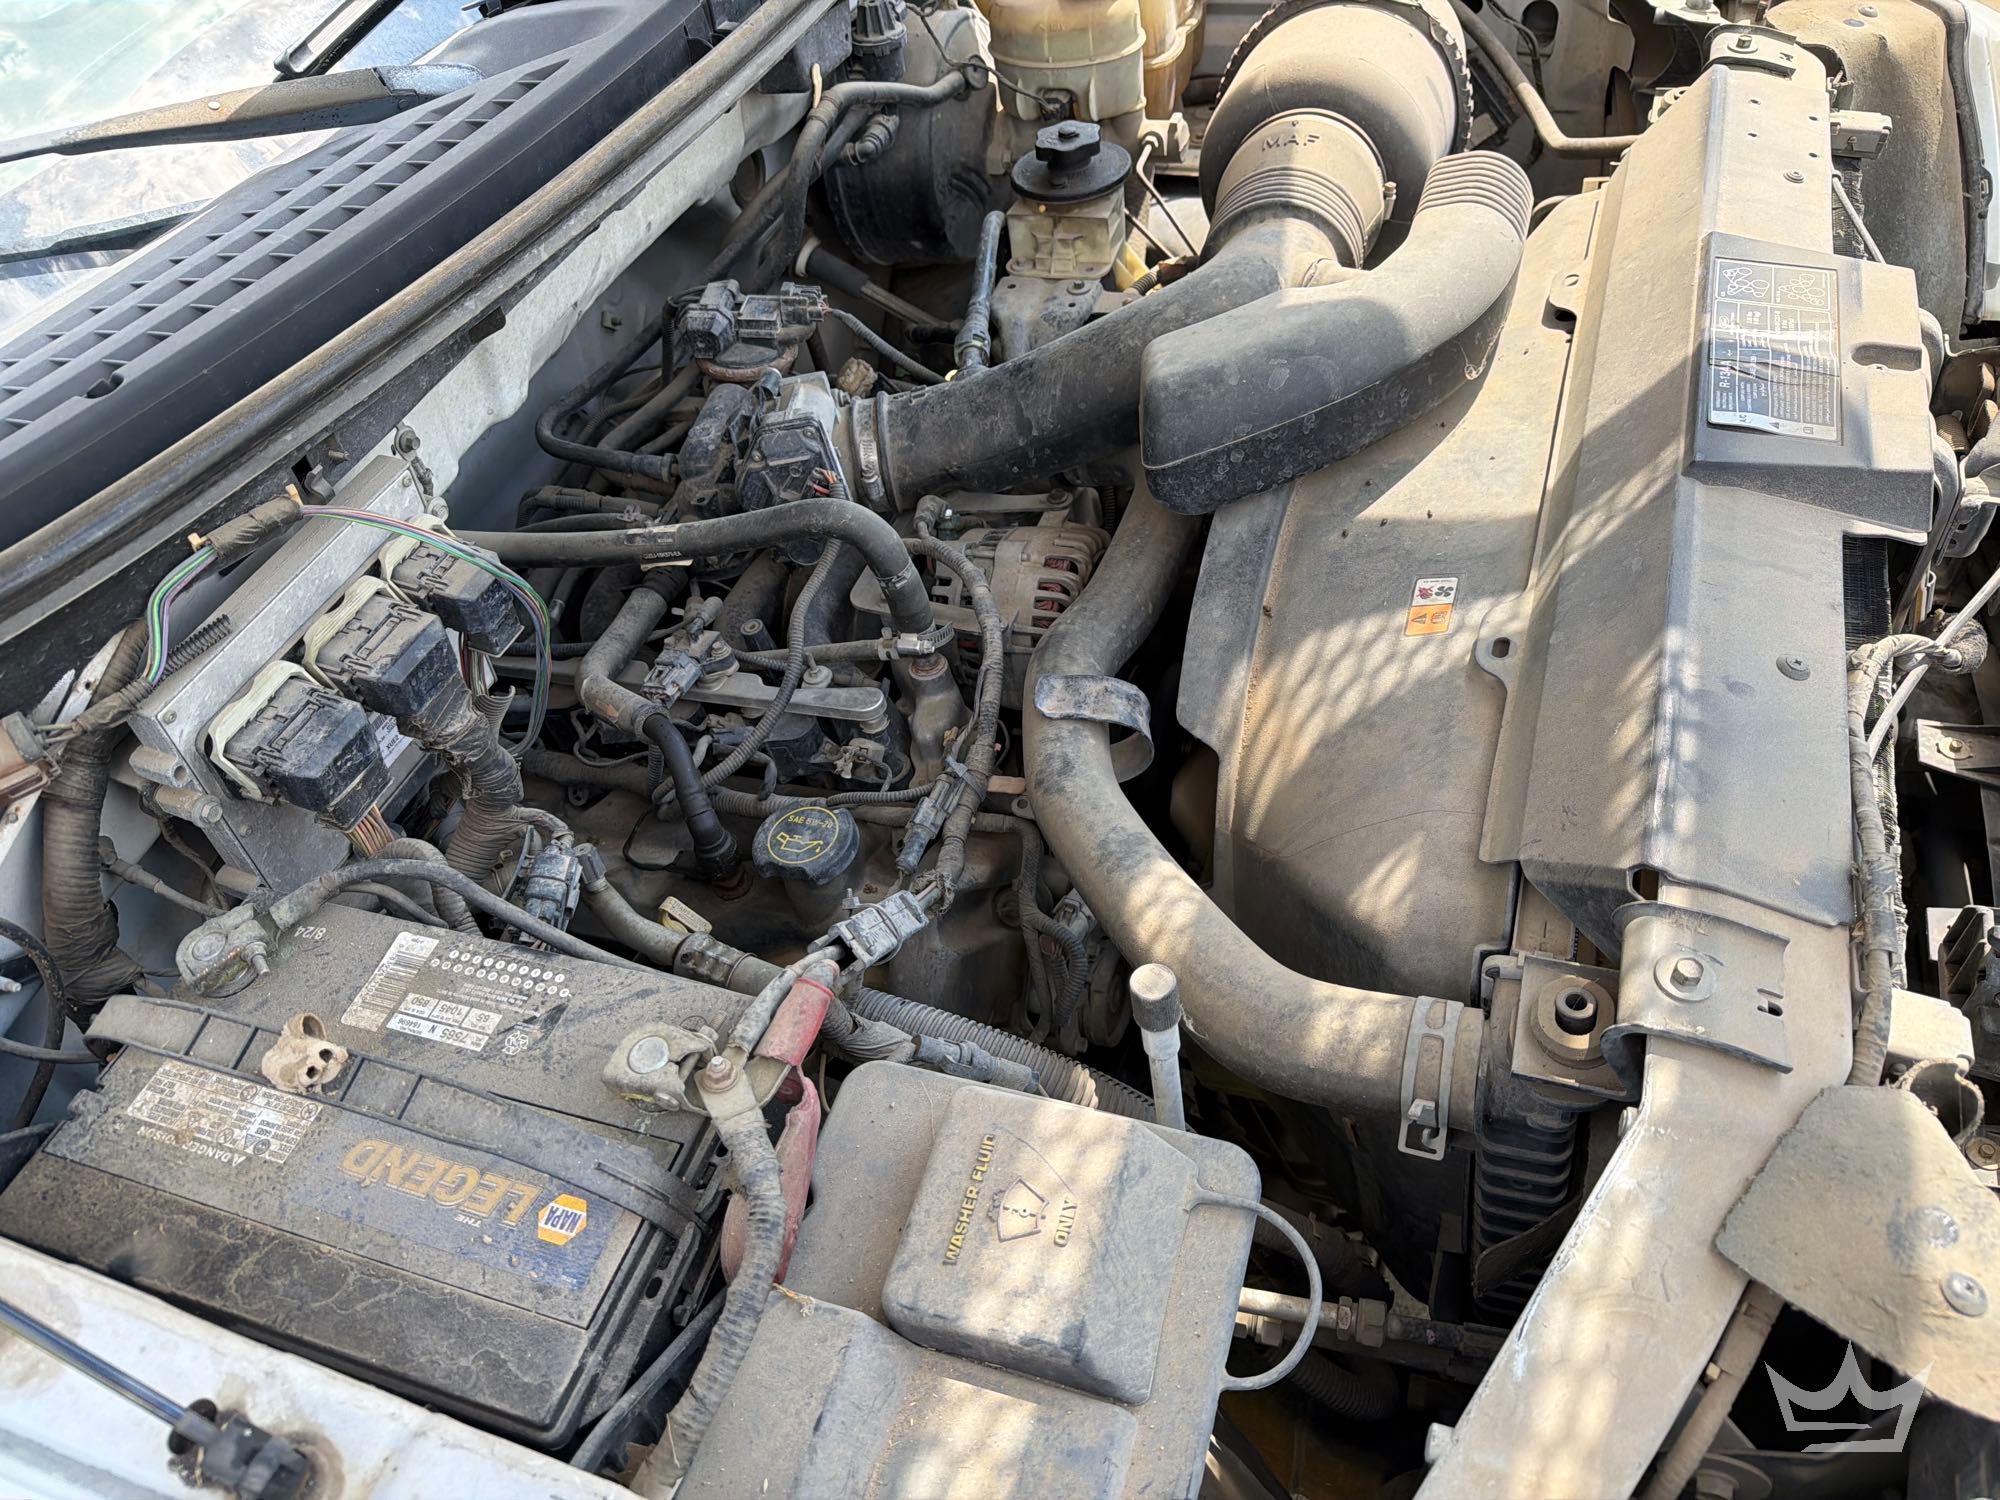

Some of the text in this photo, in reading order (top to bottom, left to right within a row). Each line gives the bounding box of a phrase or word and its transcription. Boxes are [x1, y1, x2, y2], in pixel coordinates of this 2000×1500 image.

[1259, 130, 1321, 152] MAF
[384, 733, 400, 750] XUE2
[787, 814, 806, 824] SAE
[293, 924, 327, 940] 8/24
[409, 995, 431, 1008] 850
[437, 1002, 465, 1019] 1045
[474, 1011, 492, 1024] 65
[427, 1022, 438, 1035] N
[438, 1026, 470, 1043] 7565
[181, 1138, 233, 1163] DANGER
[337, 1137, 544, 1229] LEGEND
[941, 1133, 996, 1267] WASHER FLUID
[453, 1213, 482, 1227] THE
[545, 1205, 582, 1233] NAPA
[1053, 1199, 1078, 1248] ONLY
